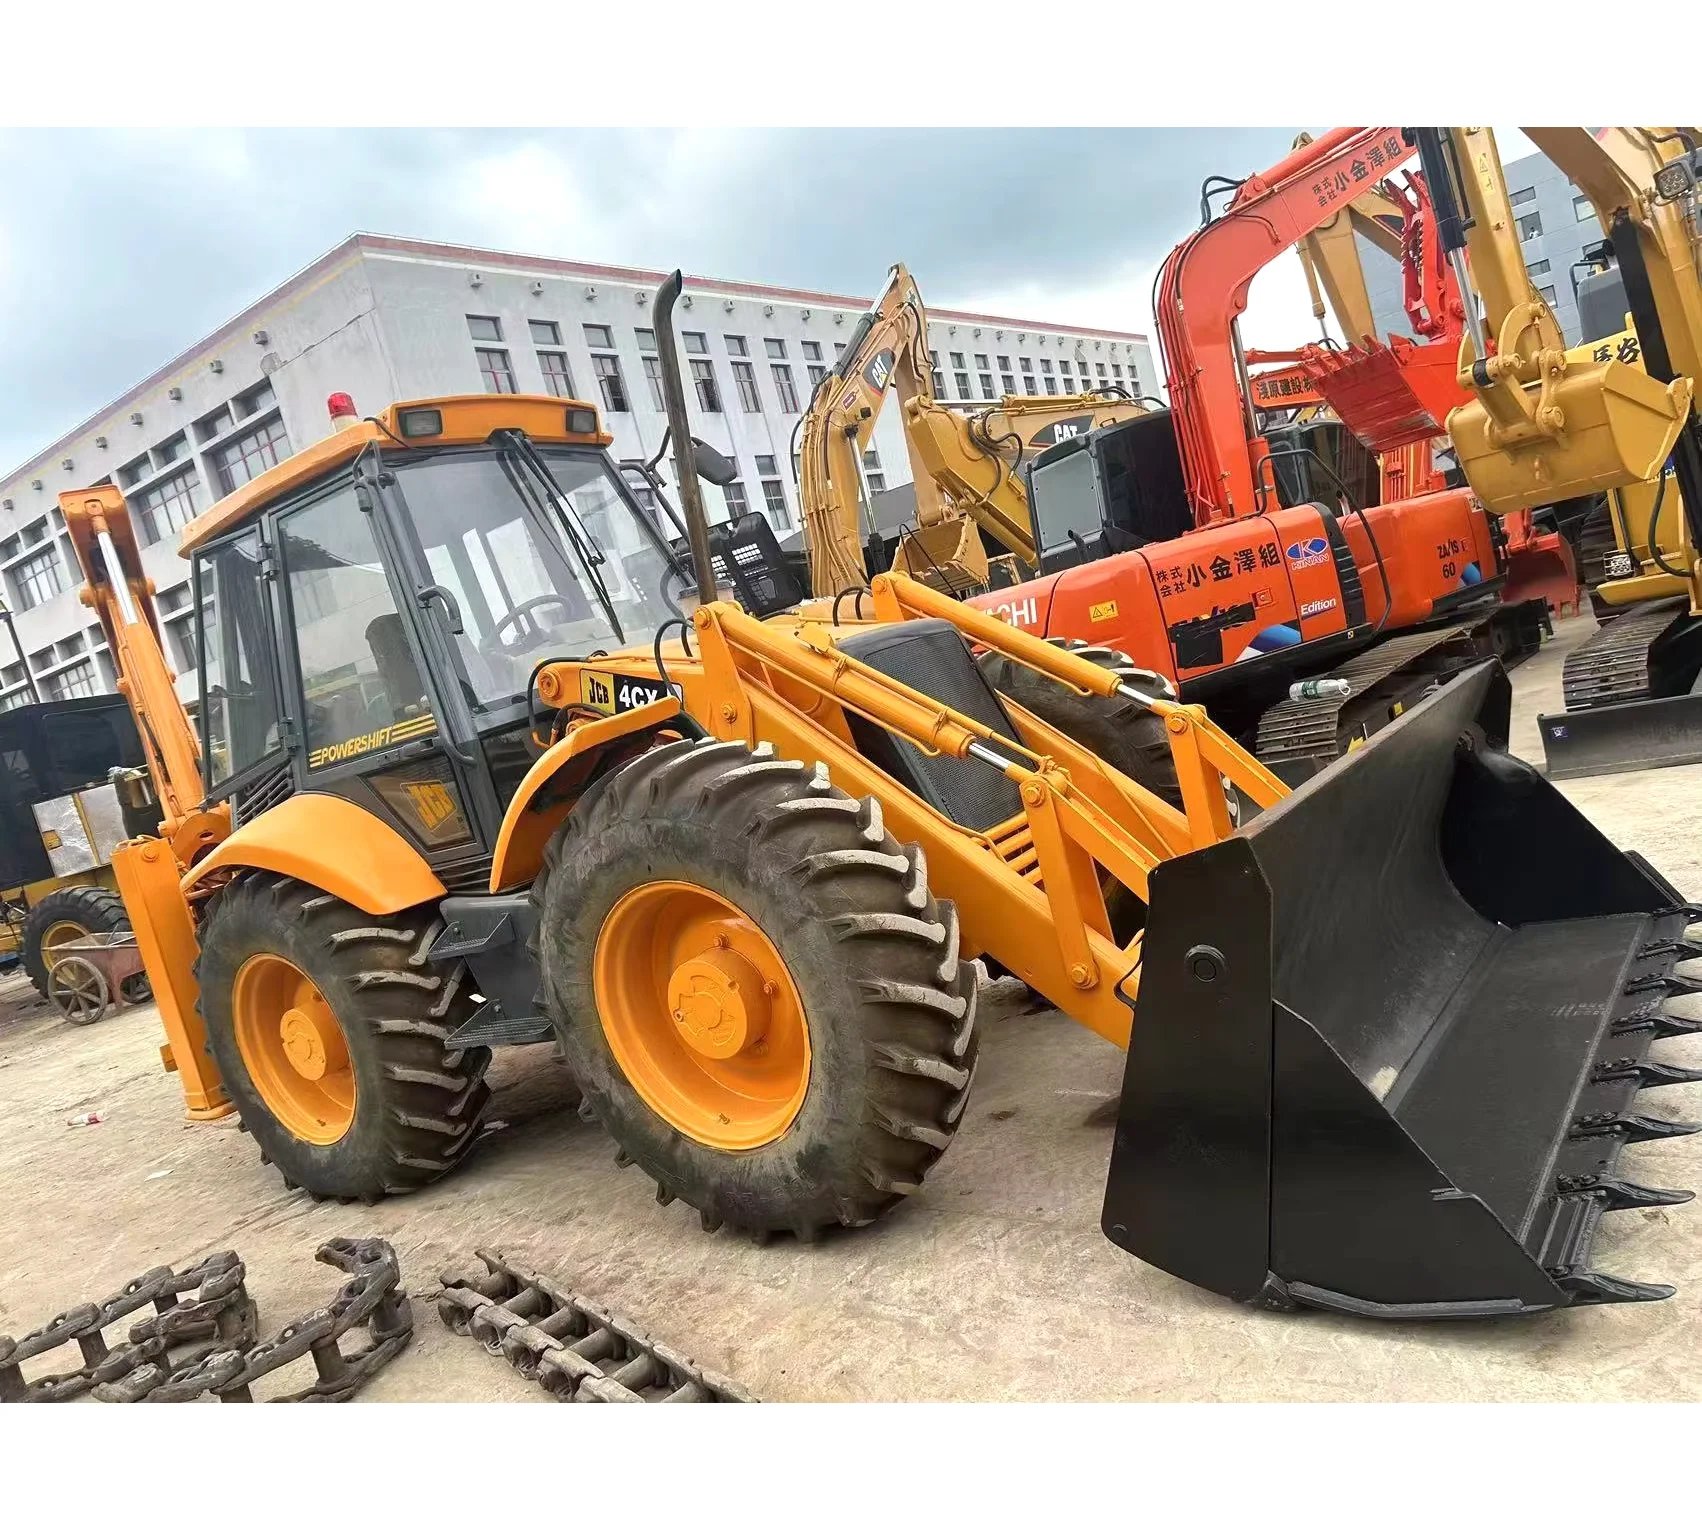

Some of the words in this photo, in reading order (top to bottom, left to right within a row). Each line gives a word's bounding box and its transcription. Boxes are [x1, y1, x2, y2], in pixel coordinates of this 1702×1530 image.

[872, 353, 889, 389] CAT
[1053, 424, 1078, 444] CAT
[1187, 542, 1281, 588] 小金澤組
[1291, 552, 1330, 571] KINAN
[1442, 562, 1456, 578] 60
[1156, 566, 1183, 584] 株式
[1160, 580, 1187, 598] 会社
[983, 597, 1038, 627] CHI
[1300, 597, 1337, 616] Edition
[588, 676, 610, 704] JCB
[619, 684, 658, 709] 4CX
[321, 727, 393, 764] POWERSHIFT
[407, 783, 455, 830] JCB
